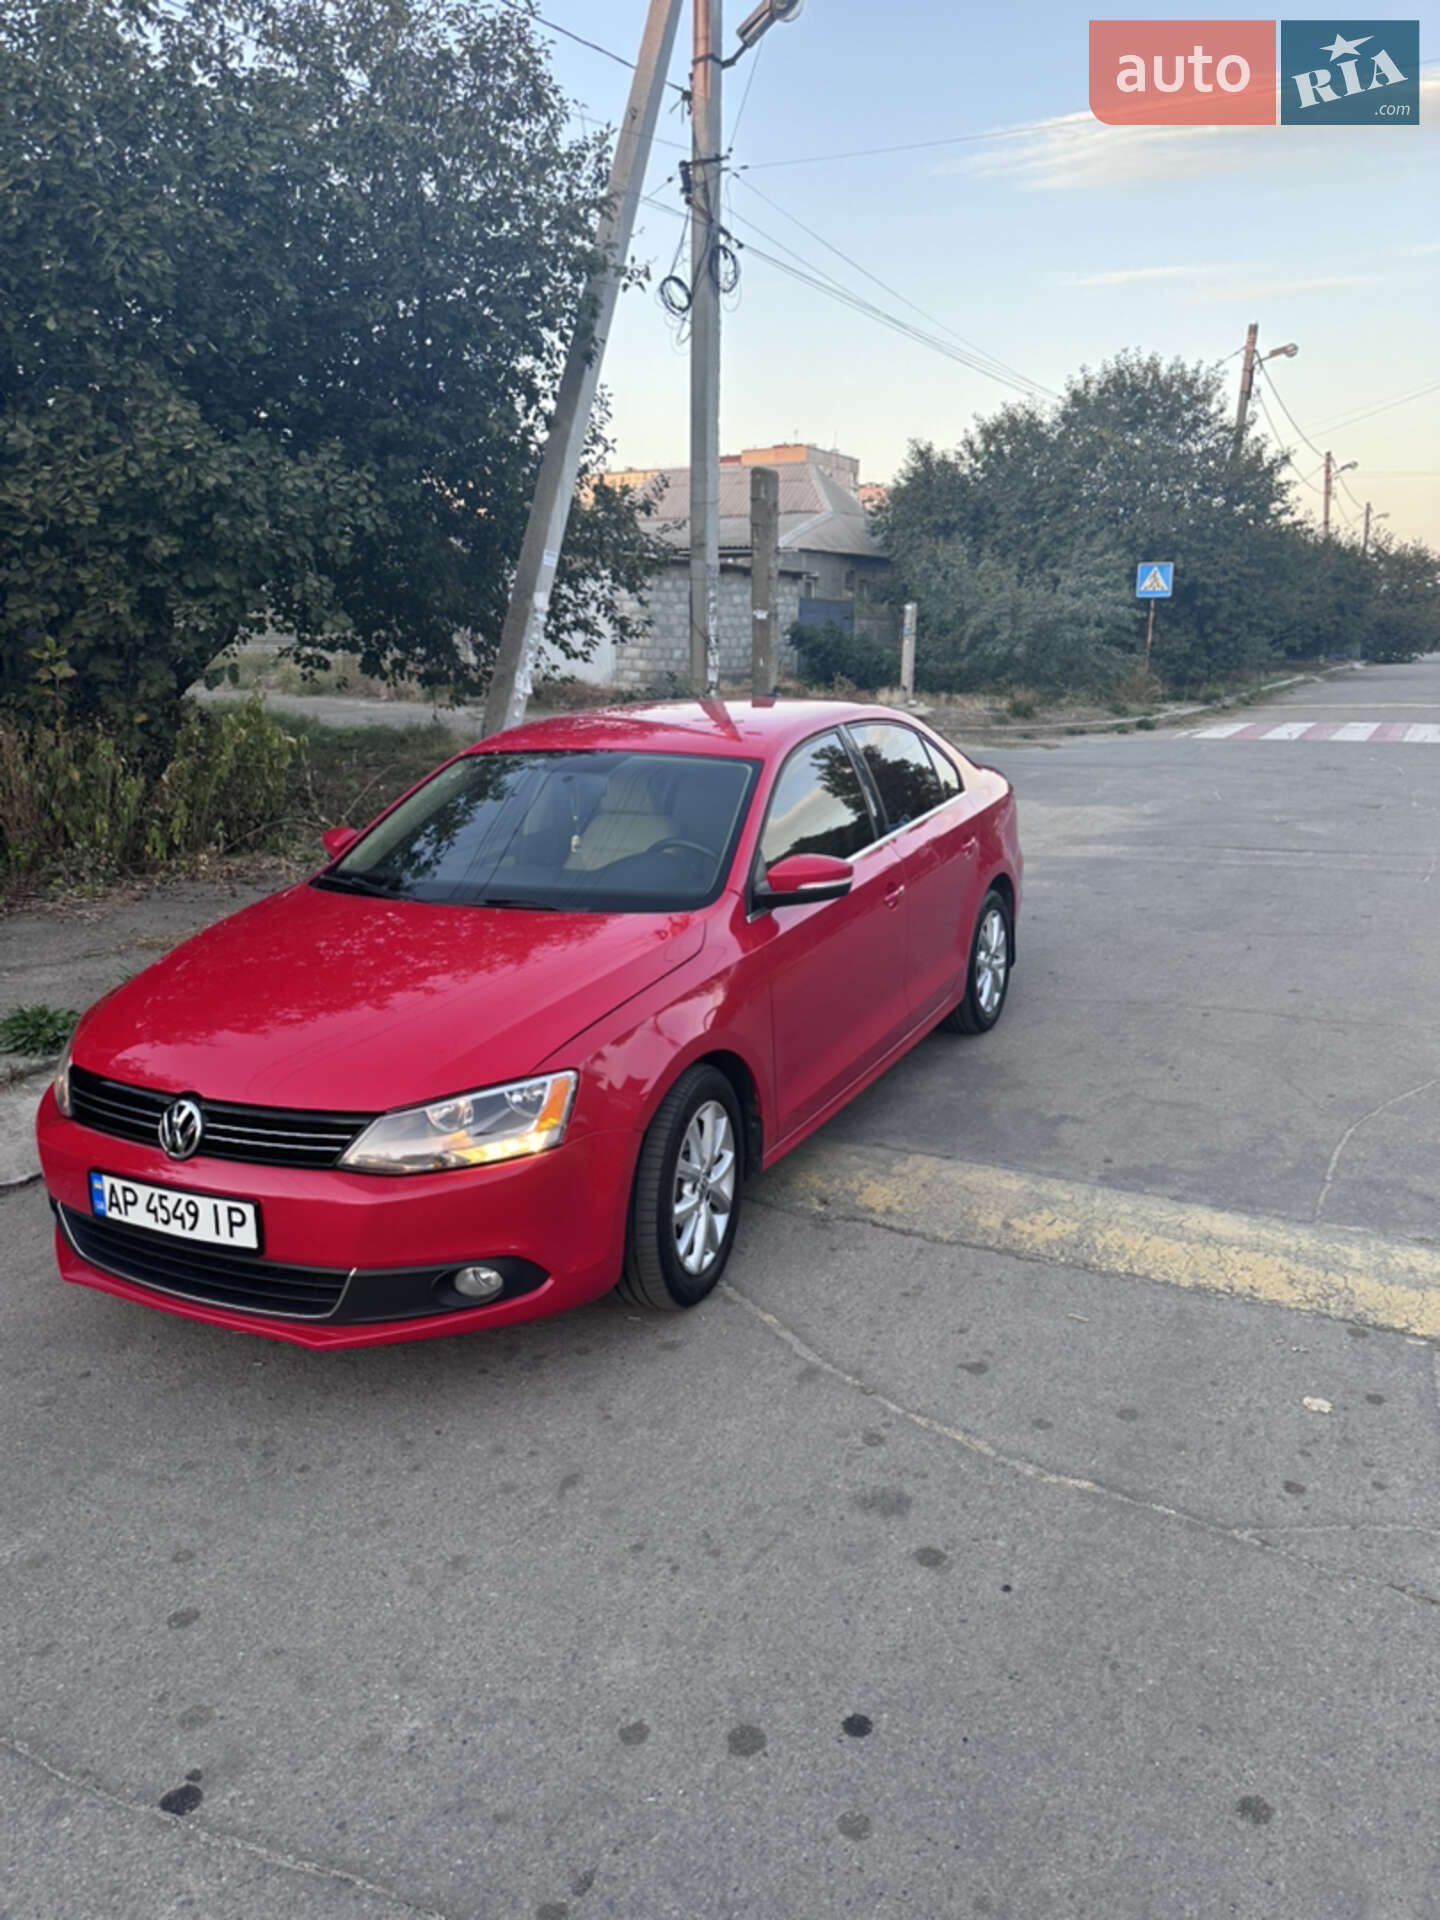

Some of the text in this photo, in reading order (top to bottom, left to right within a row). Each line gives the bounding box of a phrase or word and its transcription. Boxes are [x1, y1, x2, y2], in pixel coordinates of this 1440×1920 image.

[108, 1183, 246, 1238] AP 4549 IP
